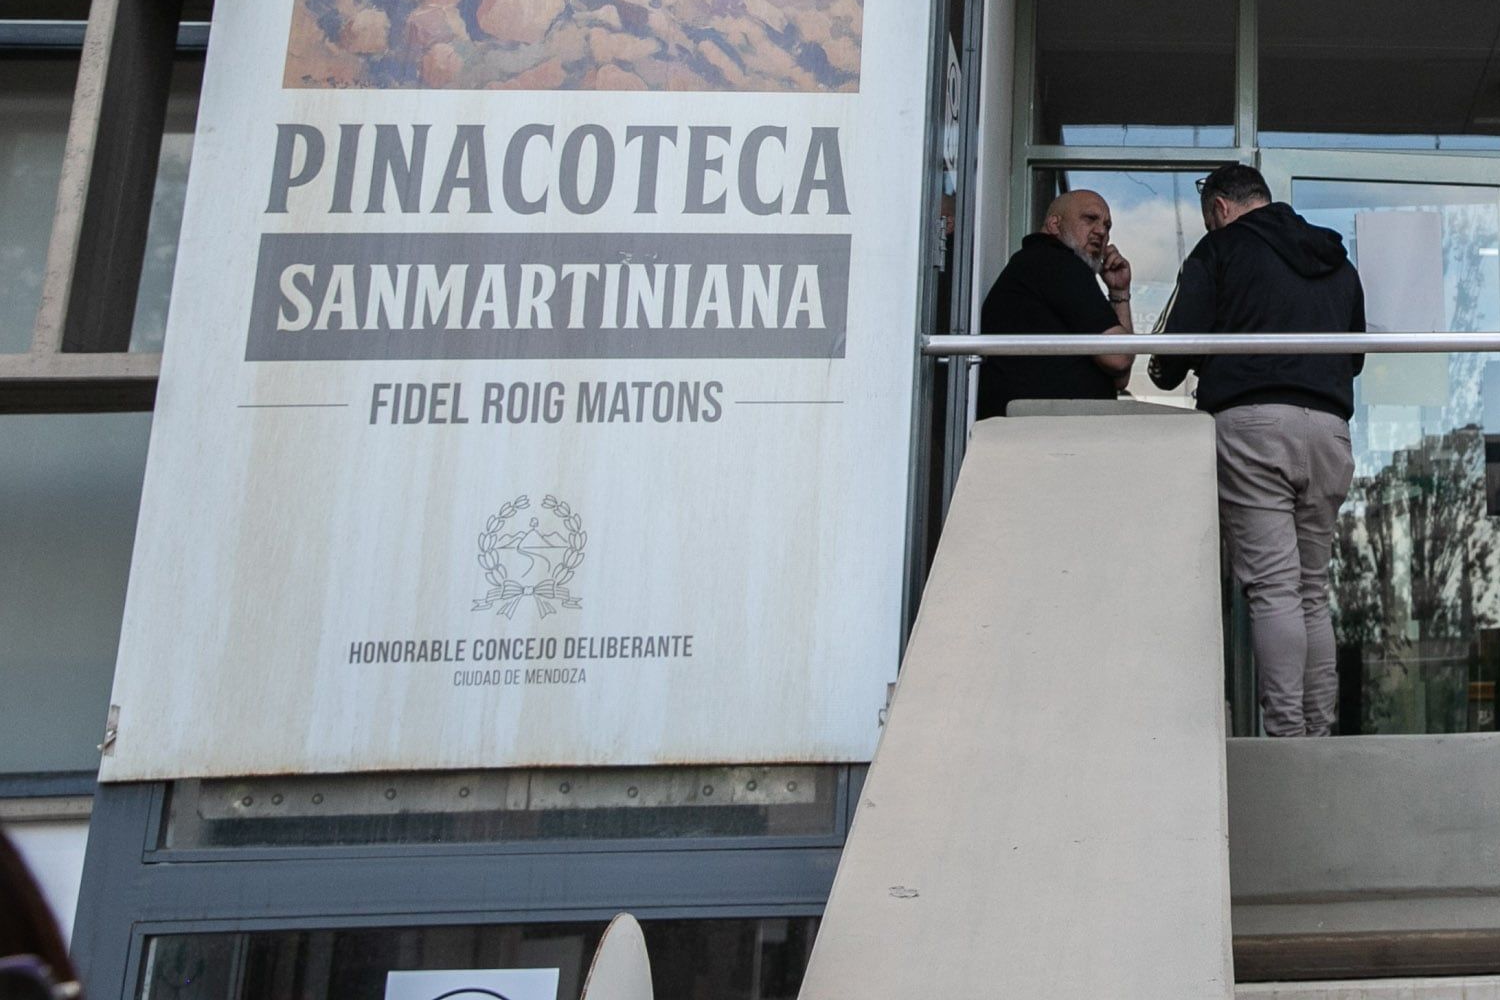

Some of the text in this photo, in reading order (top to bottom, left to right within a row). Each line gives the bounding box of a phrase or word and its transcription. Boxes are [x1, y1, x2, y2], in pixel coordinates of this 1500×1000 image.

[263, 122, 852, 216] PINACOTECA
[276, 262, 827, 333] SANMARTINIANA
[369, 381, 723, 425] FIDEL ROIG MATONS
[349, 635, 694, 664] HONORABLE CONCEJO DELIBERANTE
[453, 668, 587, 686] CIUDAD DE MENDOZA
